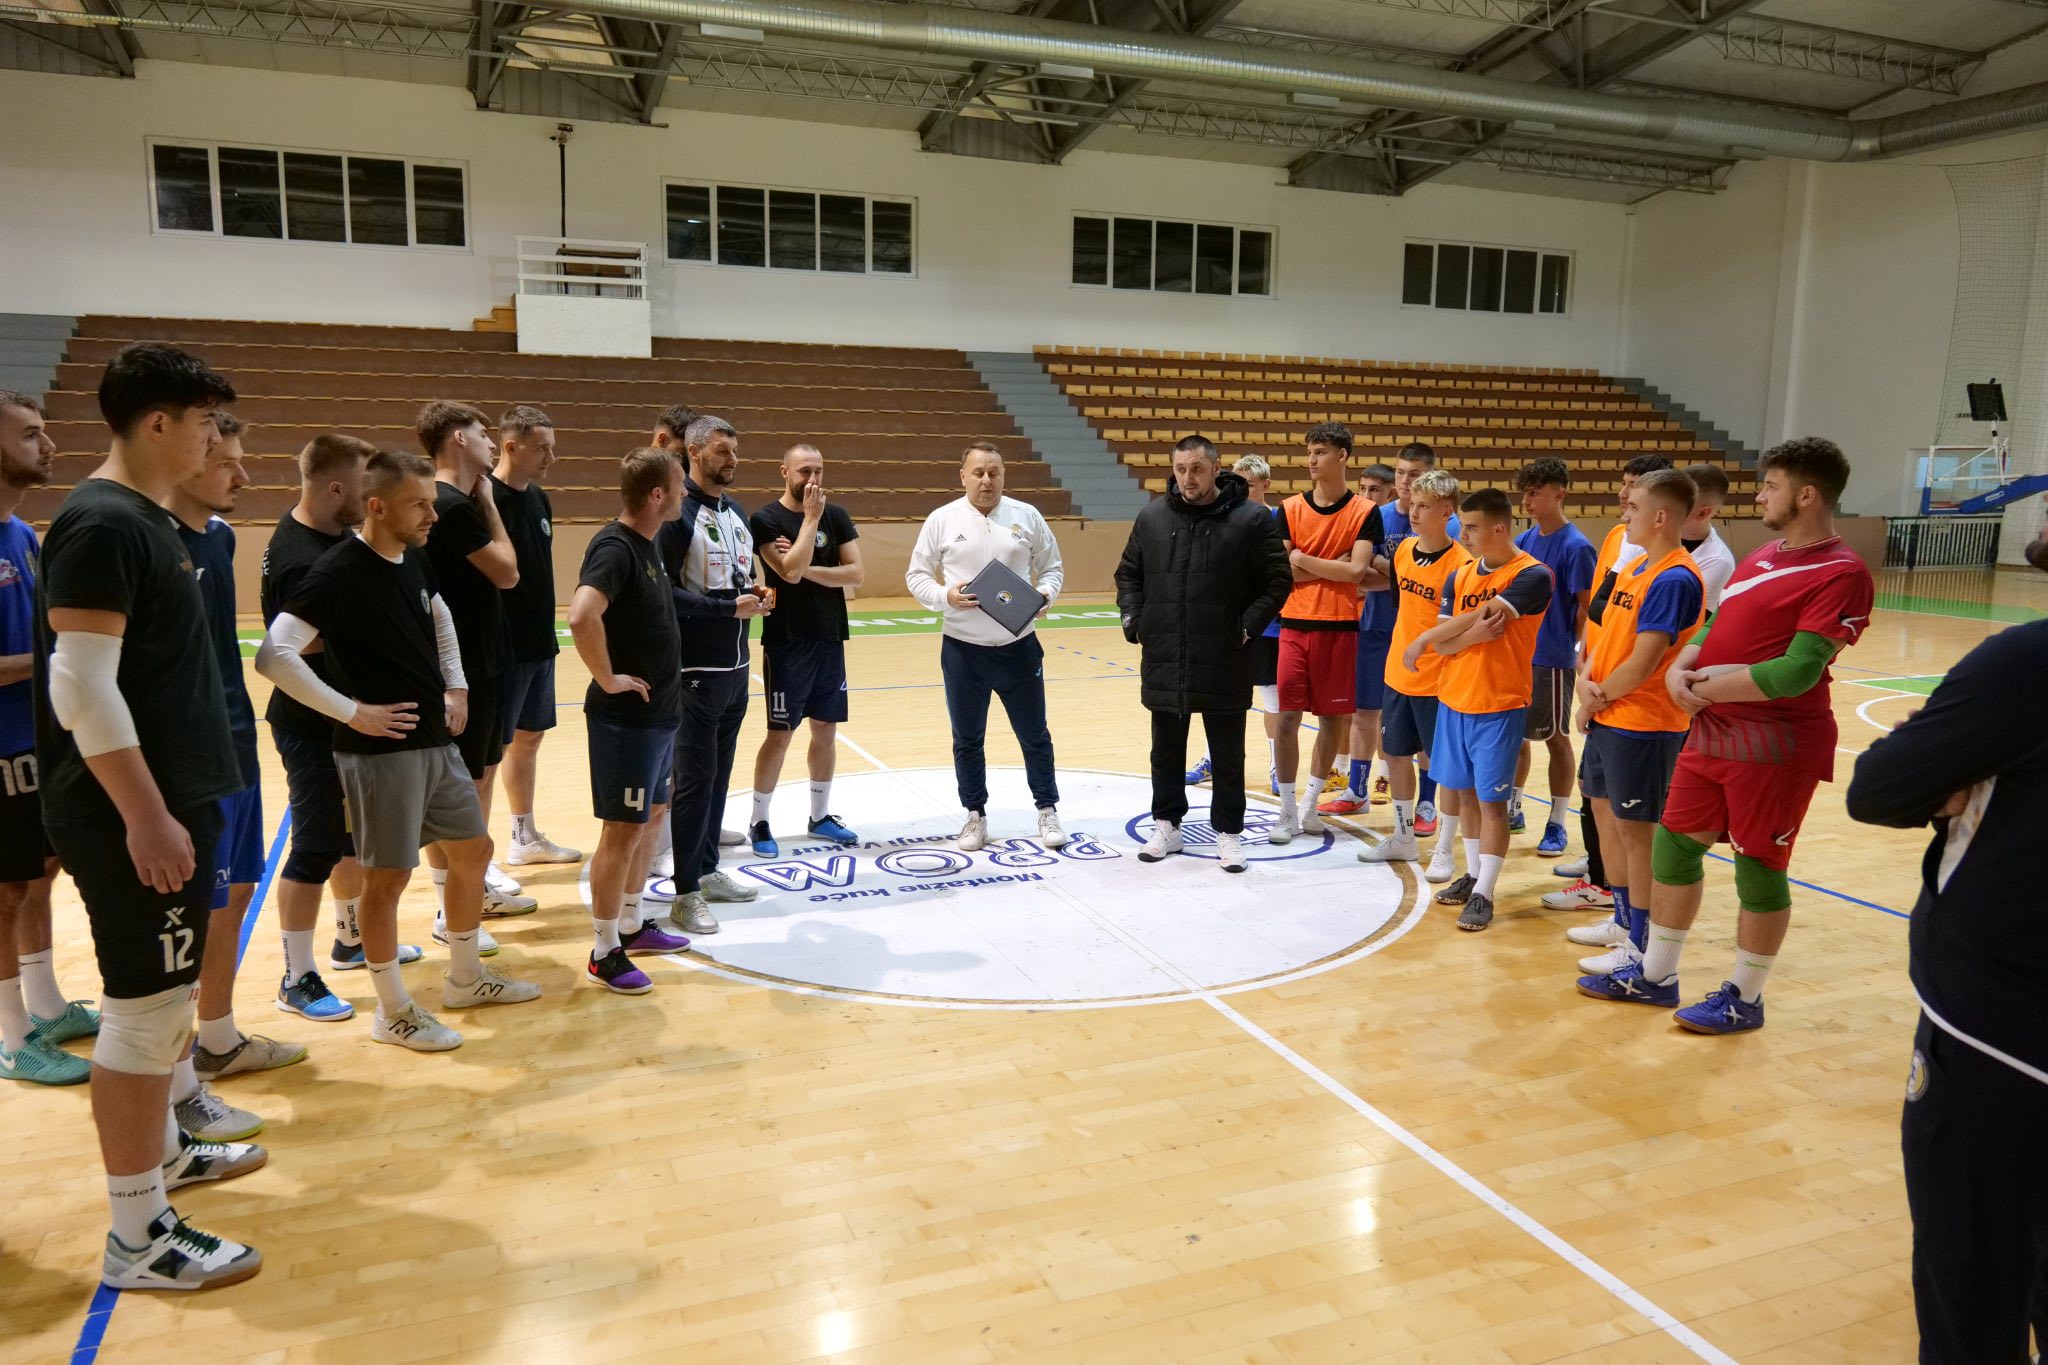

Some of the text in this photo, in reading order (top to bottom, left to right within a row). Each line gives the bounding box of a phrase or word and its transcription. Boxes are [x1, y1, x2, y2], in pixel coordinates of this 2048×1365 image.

[773, 691, 786, 712] 11
[624, 787, 645, 812] 4
[158, 927, 195, 974] 12
